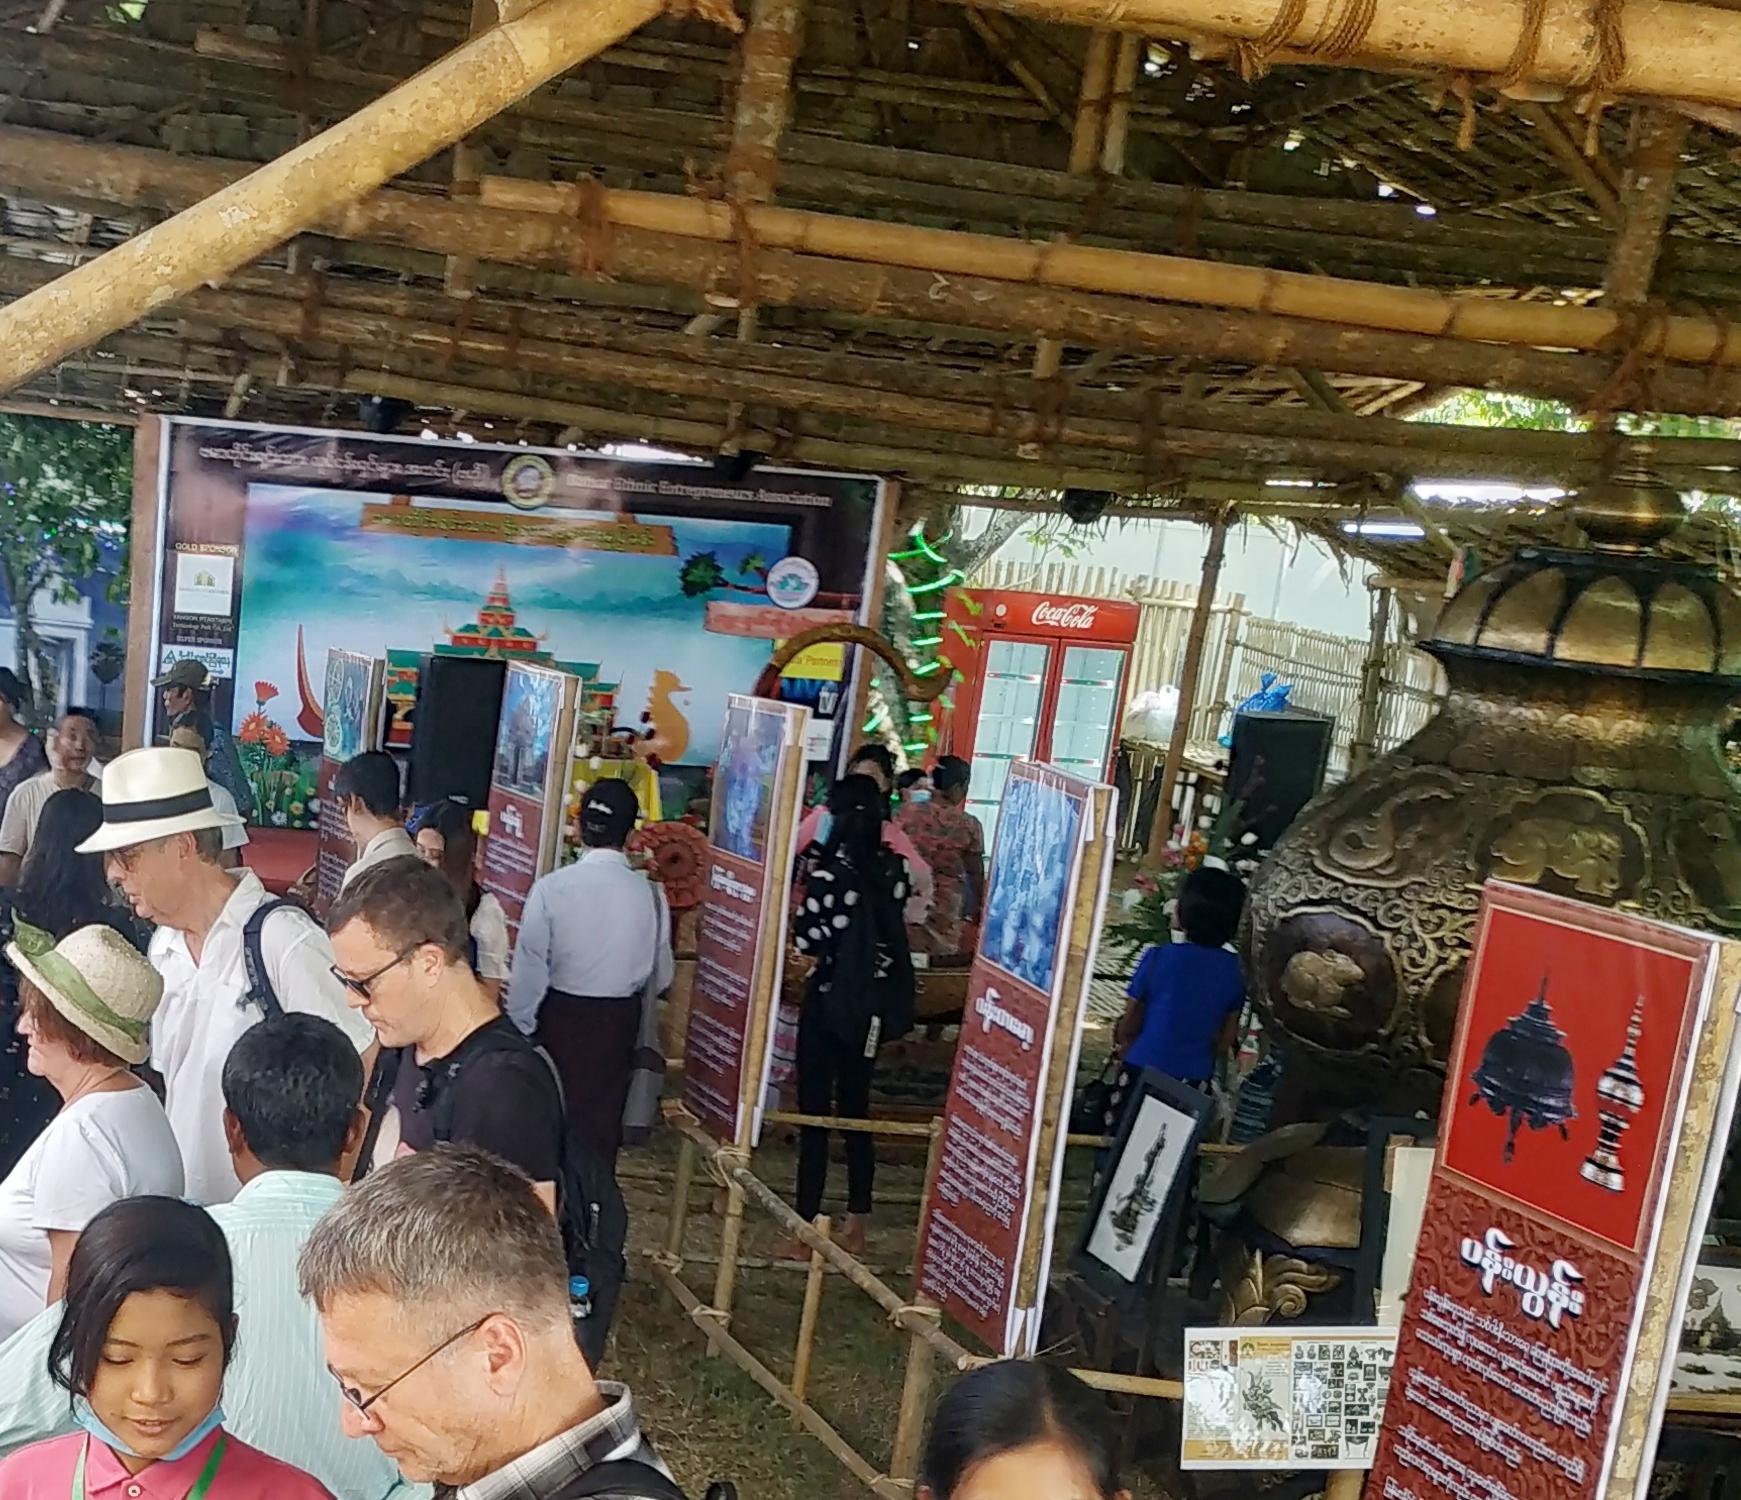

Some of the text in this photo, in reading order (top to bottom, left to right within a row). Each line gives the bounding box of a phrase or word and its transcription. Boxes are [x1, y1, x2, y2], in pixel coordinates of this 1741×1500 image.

[175, 543, 197, 551] GOLD
[1460, 1226, 1583, 1329] ပန်းယွန်း
